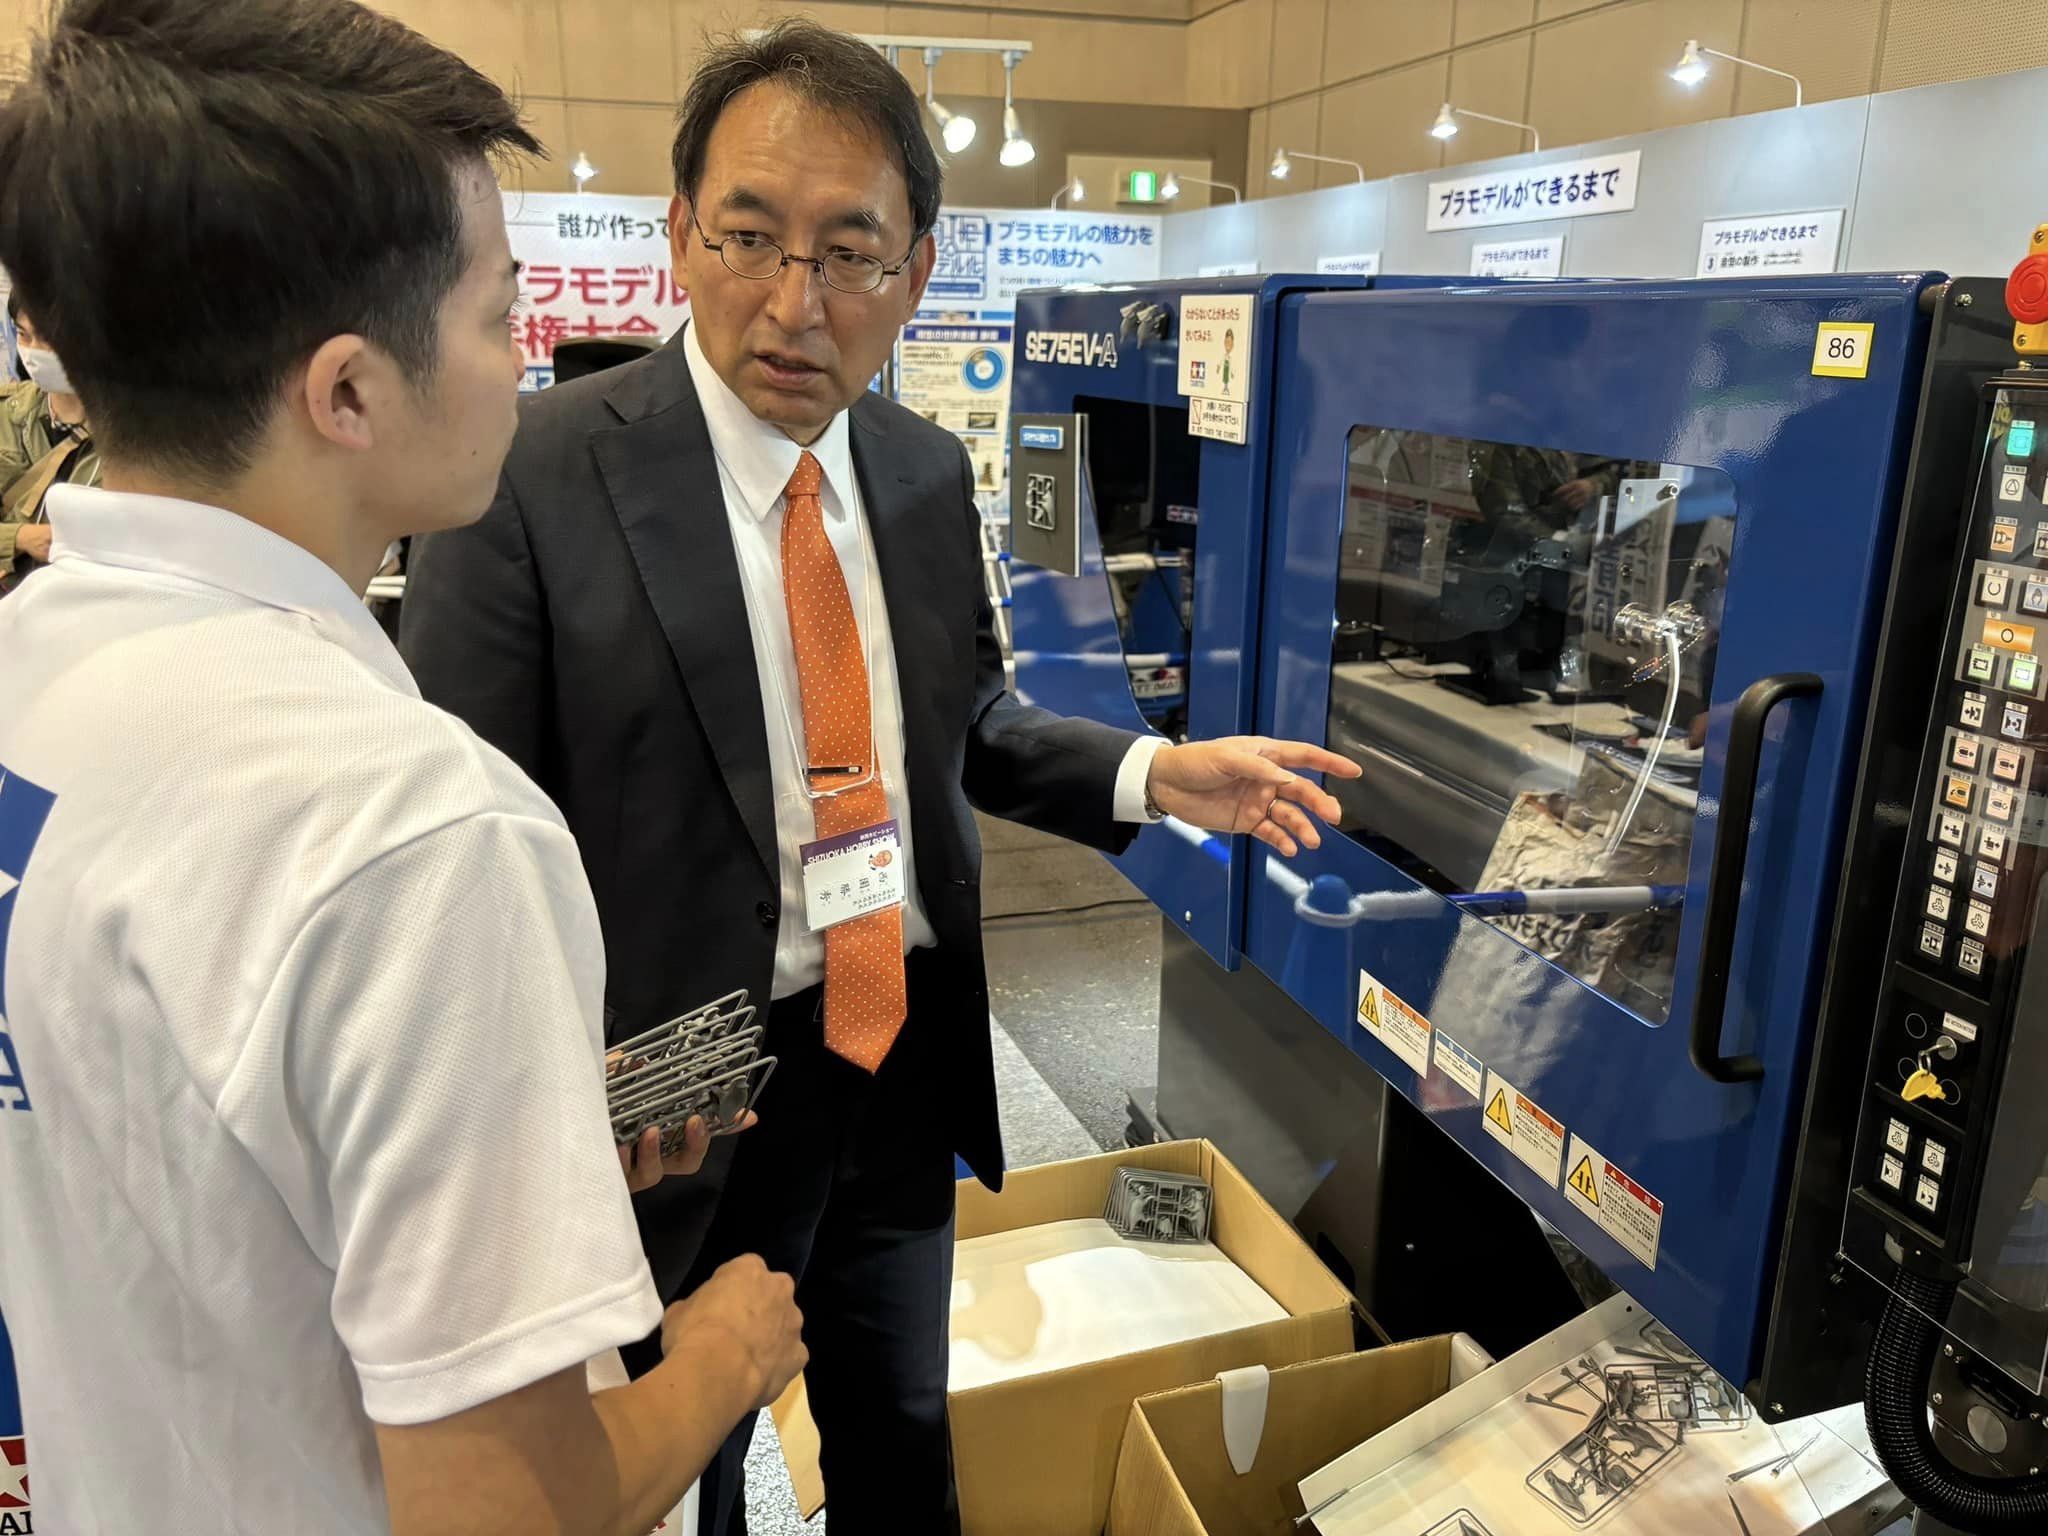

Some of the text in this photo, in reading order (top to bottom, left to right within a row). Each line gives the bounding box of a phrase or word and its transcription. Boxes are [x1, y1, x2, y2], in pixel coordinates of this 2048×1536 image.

[1439, 167, 1620, 218] プラモデルができるまで
[998, 222, 1154, 246] プラモデルの魅力を
[1714, 224, 1818, 245] プラモデルができるまで
[998, 248, 1102, 268] まちの魅力へ
[519, 263, 689, 305] ラモデル
[1828, 337, 1855, 359] 86
